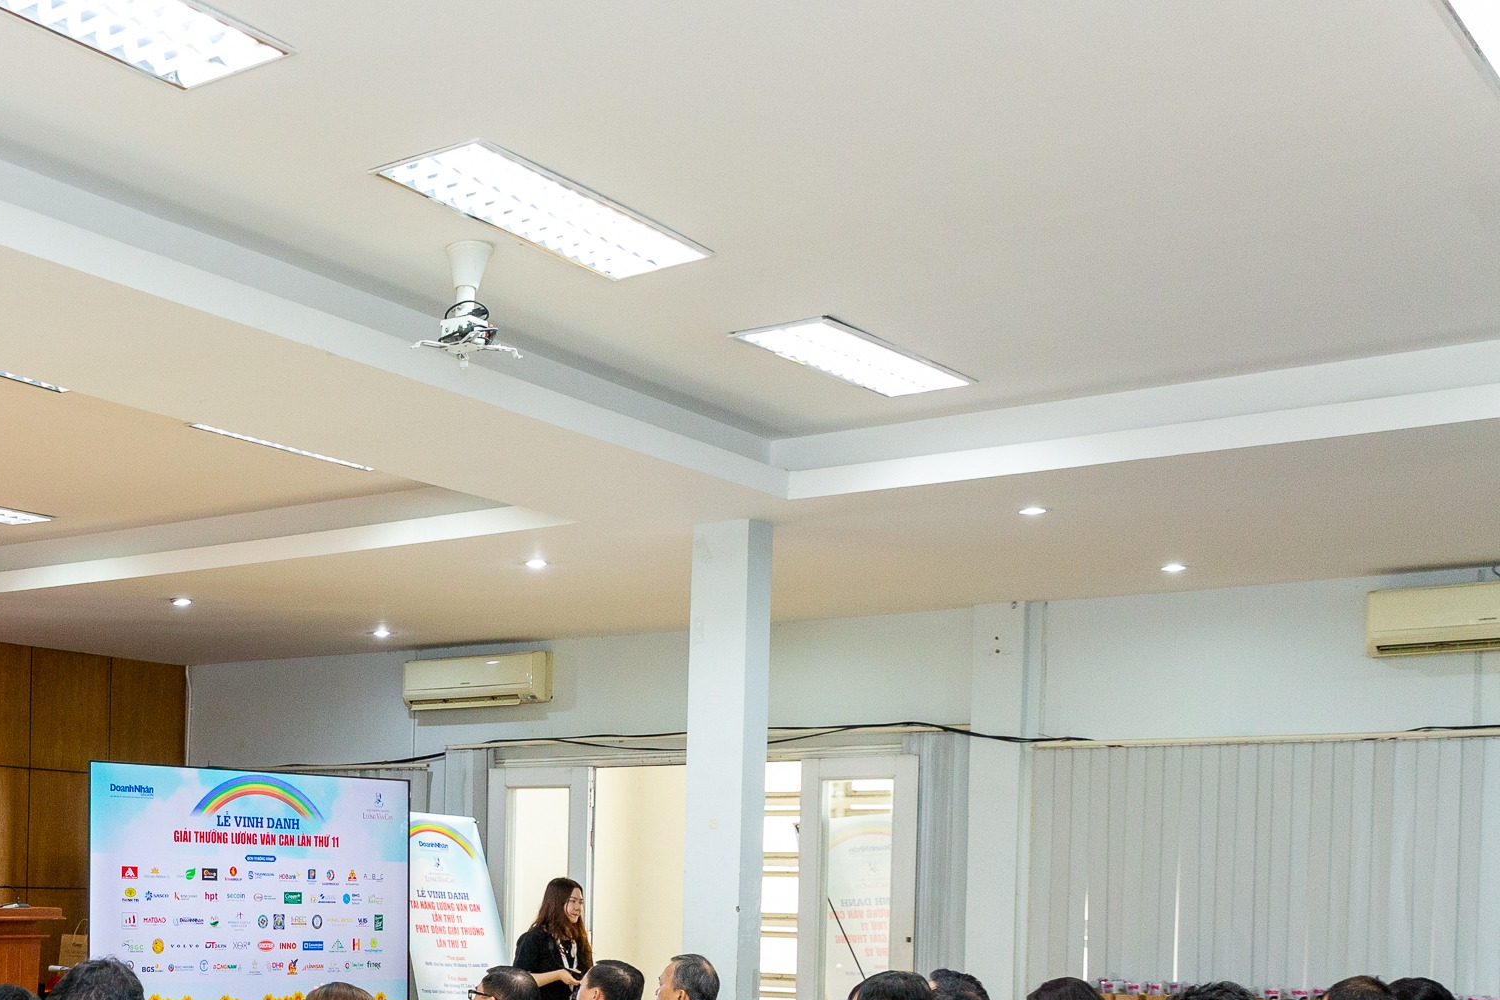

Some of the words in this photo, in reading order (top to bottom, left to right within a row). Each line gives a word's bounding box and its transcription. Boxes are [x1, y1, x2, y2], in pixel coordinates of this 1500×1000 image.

[110, 783, 154, 794] DoanhNhân
[235, 816, 263, 828] VINH
[267, 817, 300, 830] DANH
[231, 831, 257, 845] LƯƠNG
[278, 834, 295, 846] CAN
[332, 836, 339, 848] 11
[205, 892, 218, 902] hpt
[427, 890, 446, 899] VINH
[447, 891, 469, 900] DANH
